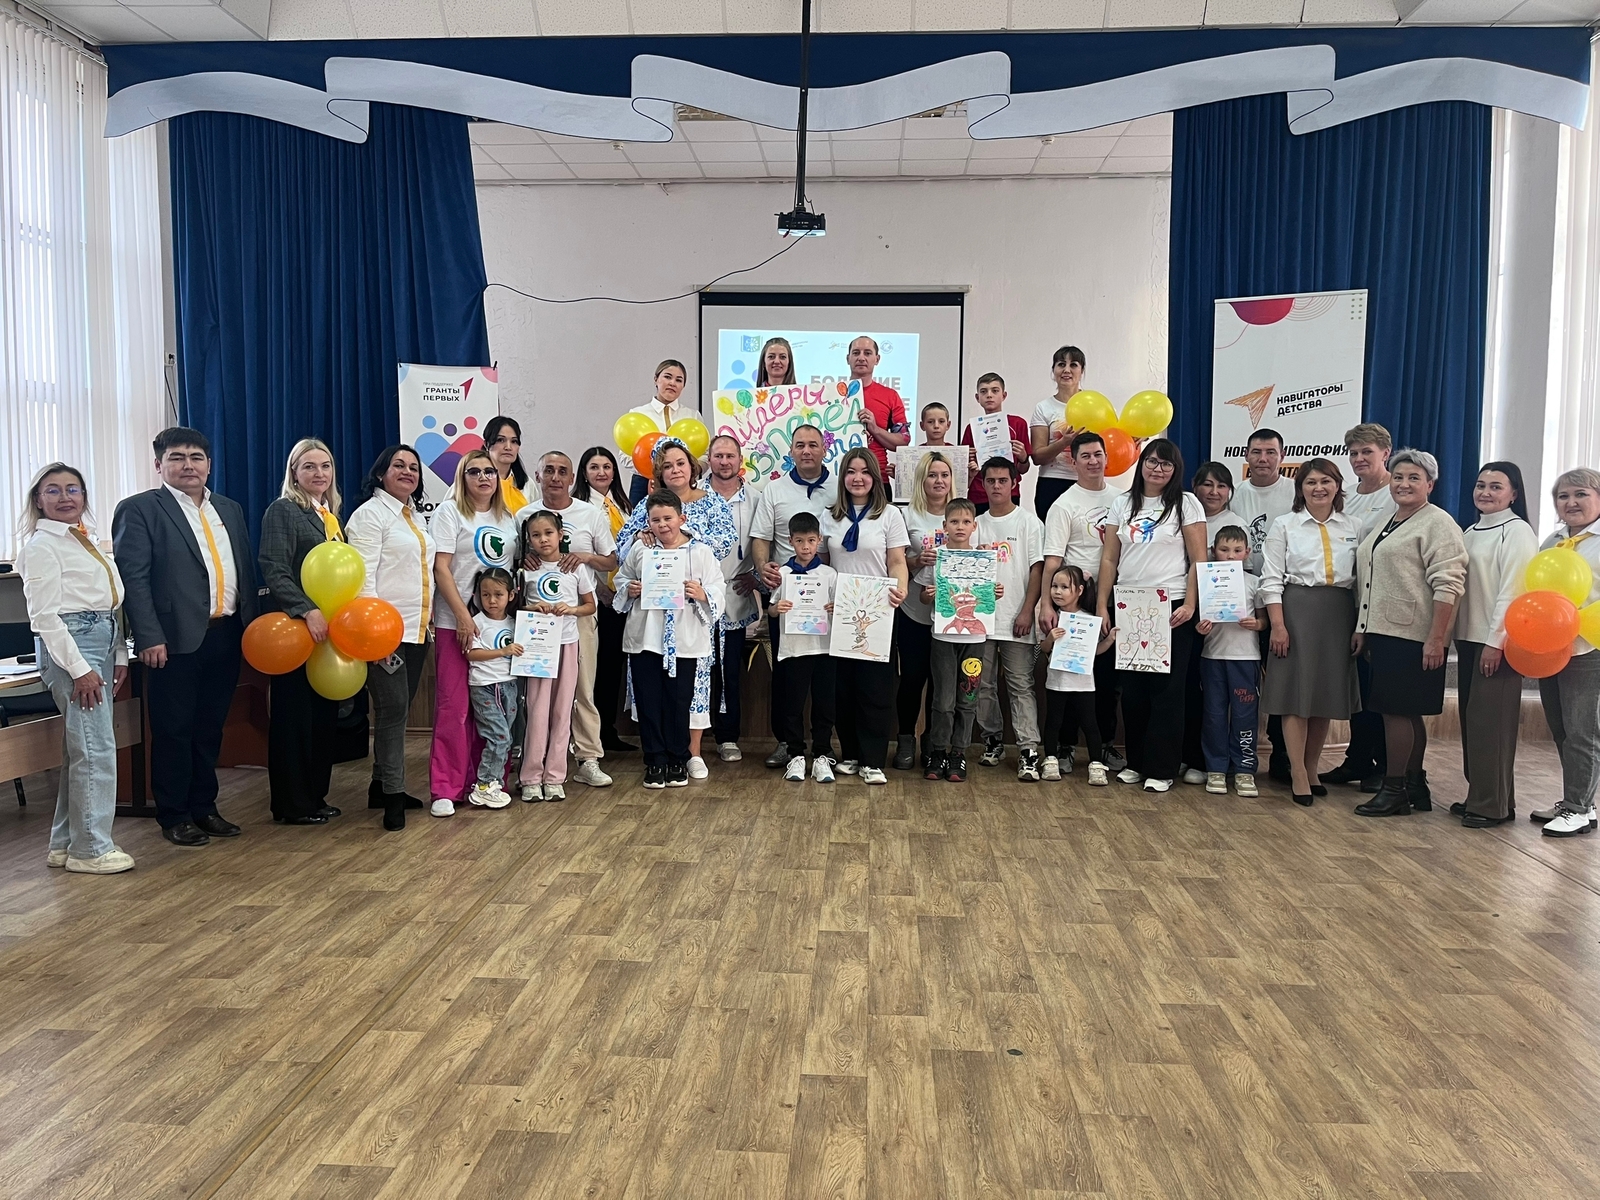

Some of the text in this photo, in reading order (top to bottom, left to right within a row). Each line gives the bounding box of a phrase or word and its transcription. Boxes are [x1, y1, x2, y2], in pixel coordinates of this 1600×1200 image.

[1276, 383, 1343, 405] НАВИГАТОРЫ
[1277, 399, 1322, 417] ДЕТСТВА
[1224, 444, 1349, 458] НОВ ИЛОСОФИЯ
